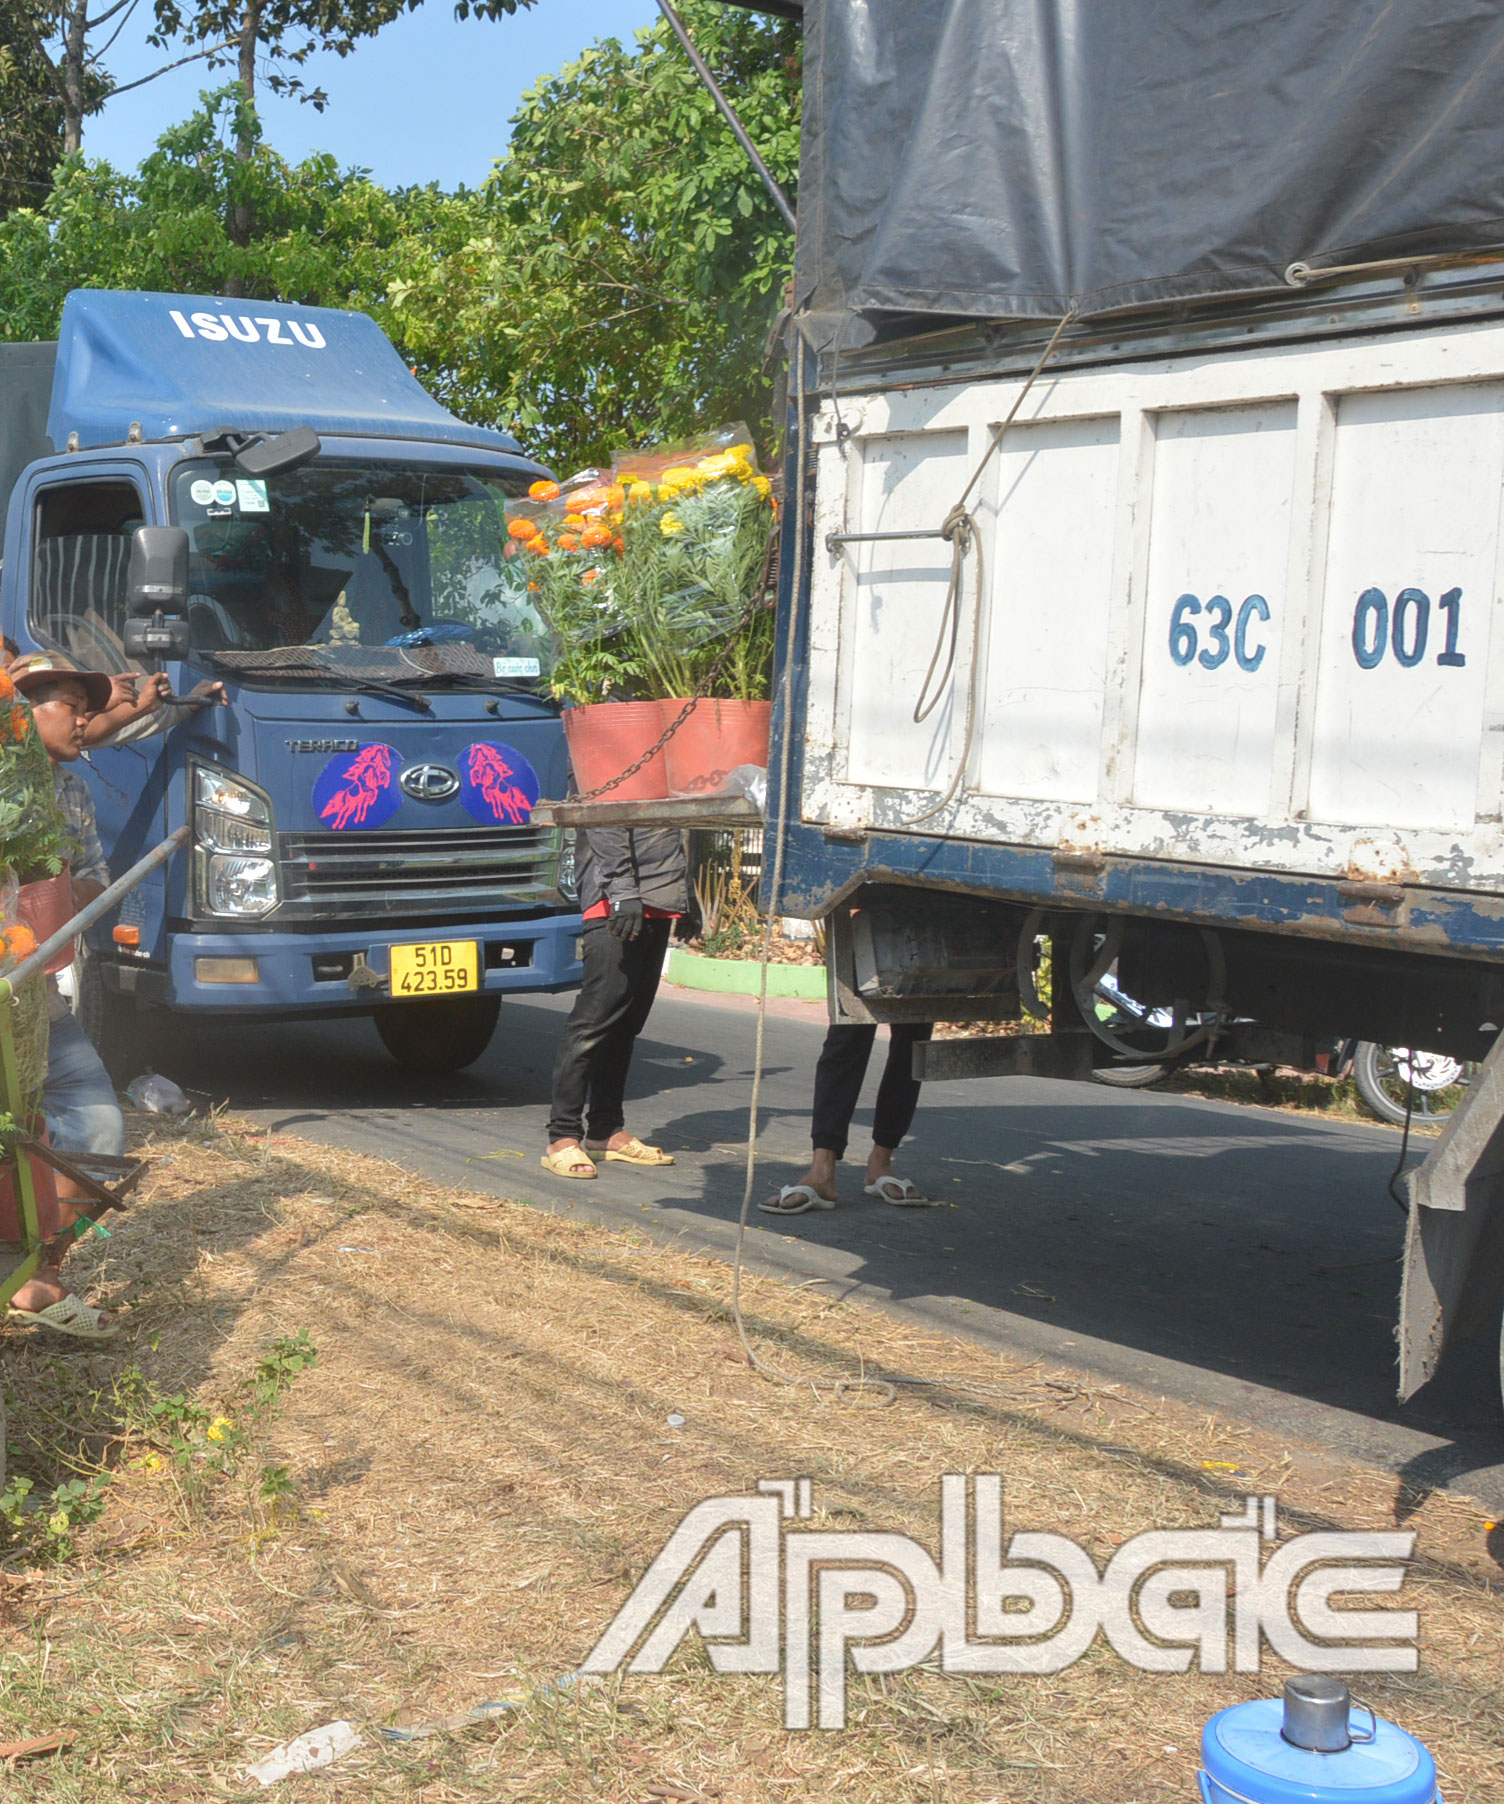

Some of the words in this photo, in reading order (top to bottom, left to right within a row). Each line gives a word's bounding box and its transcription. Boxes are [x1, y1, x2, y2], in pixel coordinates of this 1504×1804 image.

[169, 310, 327, 349] ISUZU
[1168, 593, 1271, 673] 63C
[1352, 587, 1466, 670] 001
[284, 739, 359, 753] TERACO
[415, 945, 452, 967] 51D
[400, 968, 468, 992] 423.59
